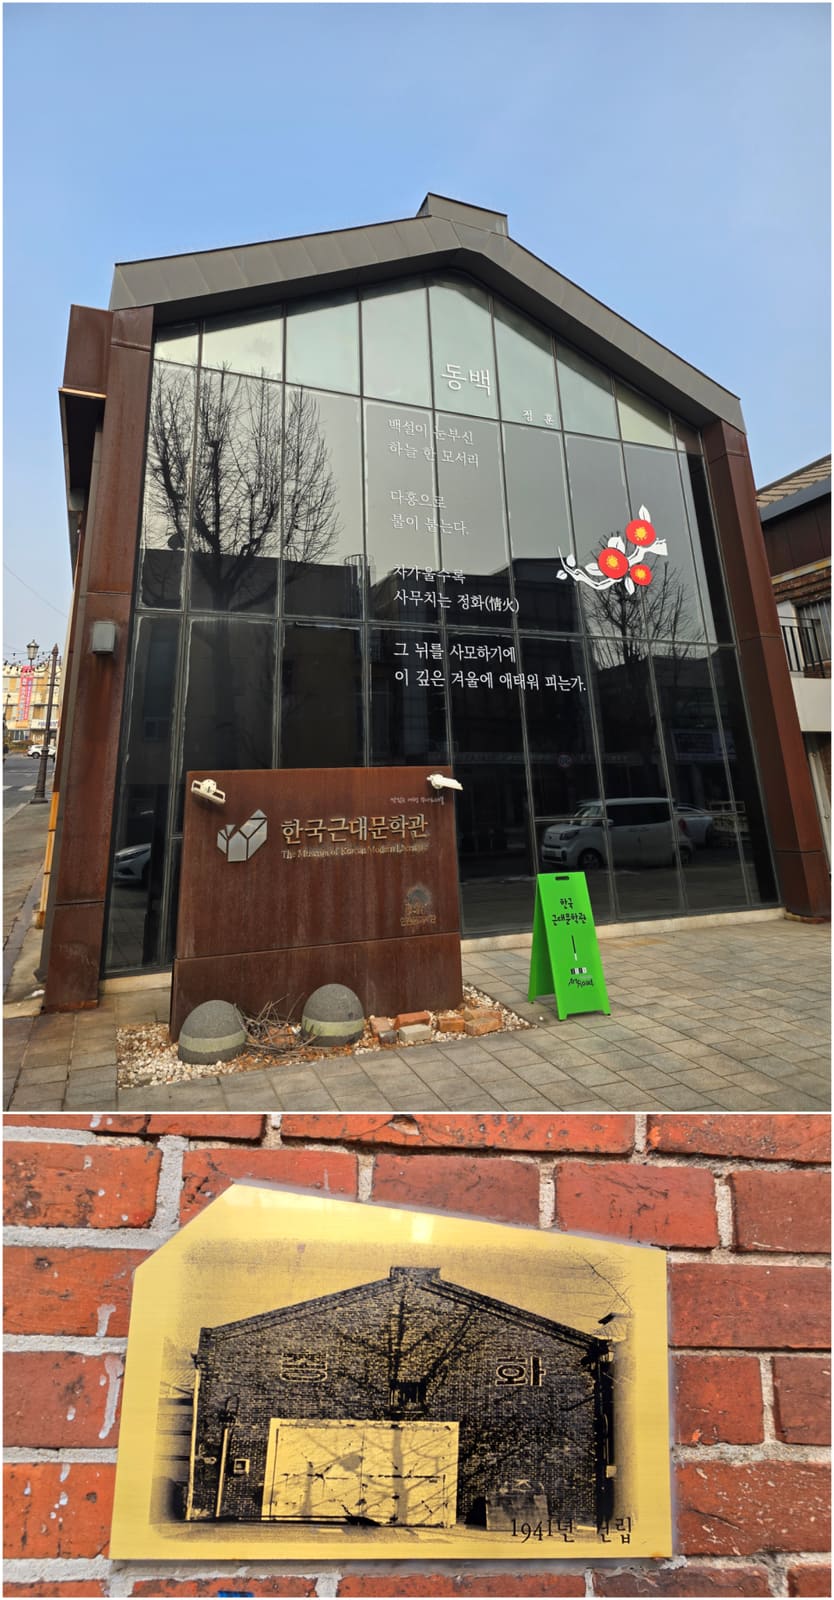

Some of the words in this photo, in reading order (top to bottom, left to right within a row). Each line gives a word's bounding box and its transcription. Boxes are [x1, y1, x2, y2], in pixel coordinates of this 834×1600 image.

[441, 363, 491, 397] 동백
[522, 409, 533, 422] 정
[388, 418, 428, 439] 백설이
[432, 424, 474, 446] 눈부신
[388, 440, 418, 459] 하늘
[423, 447, 437, 461] 한
[441, 450, 479, 468] 모서리
[390, 489, 447, 509] 다홍으로
[391, 513, 419, 531] 불이
[392, 564, 466, 585] 차가울수록
[392, 589, 452, 609] 사무치는
[457, 593, 520, 614] 정화(情火)
[393, 642, 409, 657] 그
[415, 641, 444, 660] 뉘를
[449, 643, 517, 664] 사모하기에
[394, 668, 409, 687] 이
[416, 670, 446, 688] 깊은
[450, 670, 494, 689] 겨울에
[499, 672, 540, 691] 애태워
[544, 674, 587, 693] 피는가.
[281, 813, 430, 845] 한국근대문학관
[559, 897, 574, 910] 한국
[551, 912, 587, 926] 근대문학관
[511, 1518, 575, 1544] 1941년
